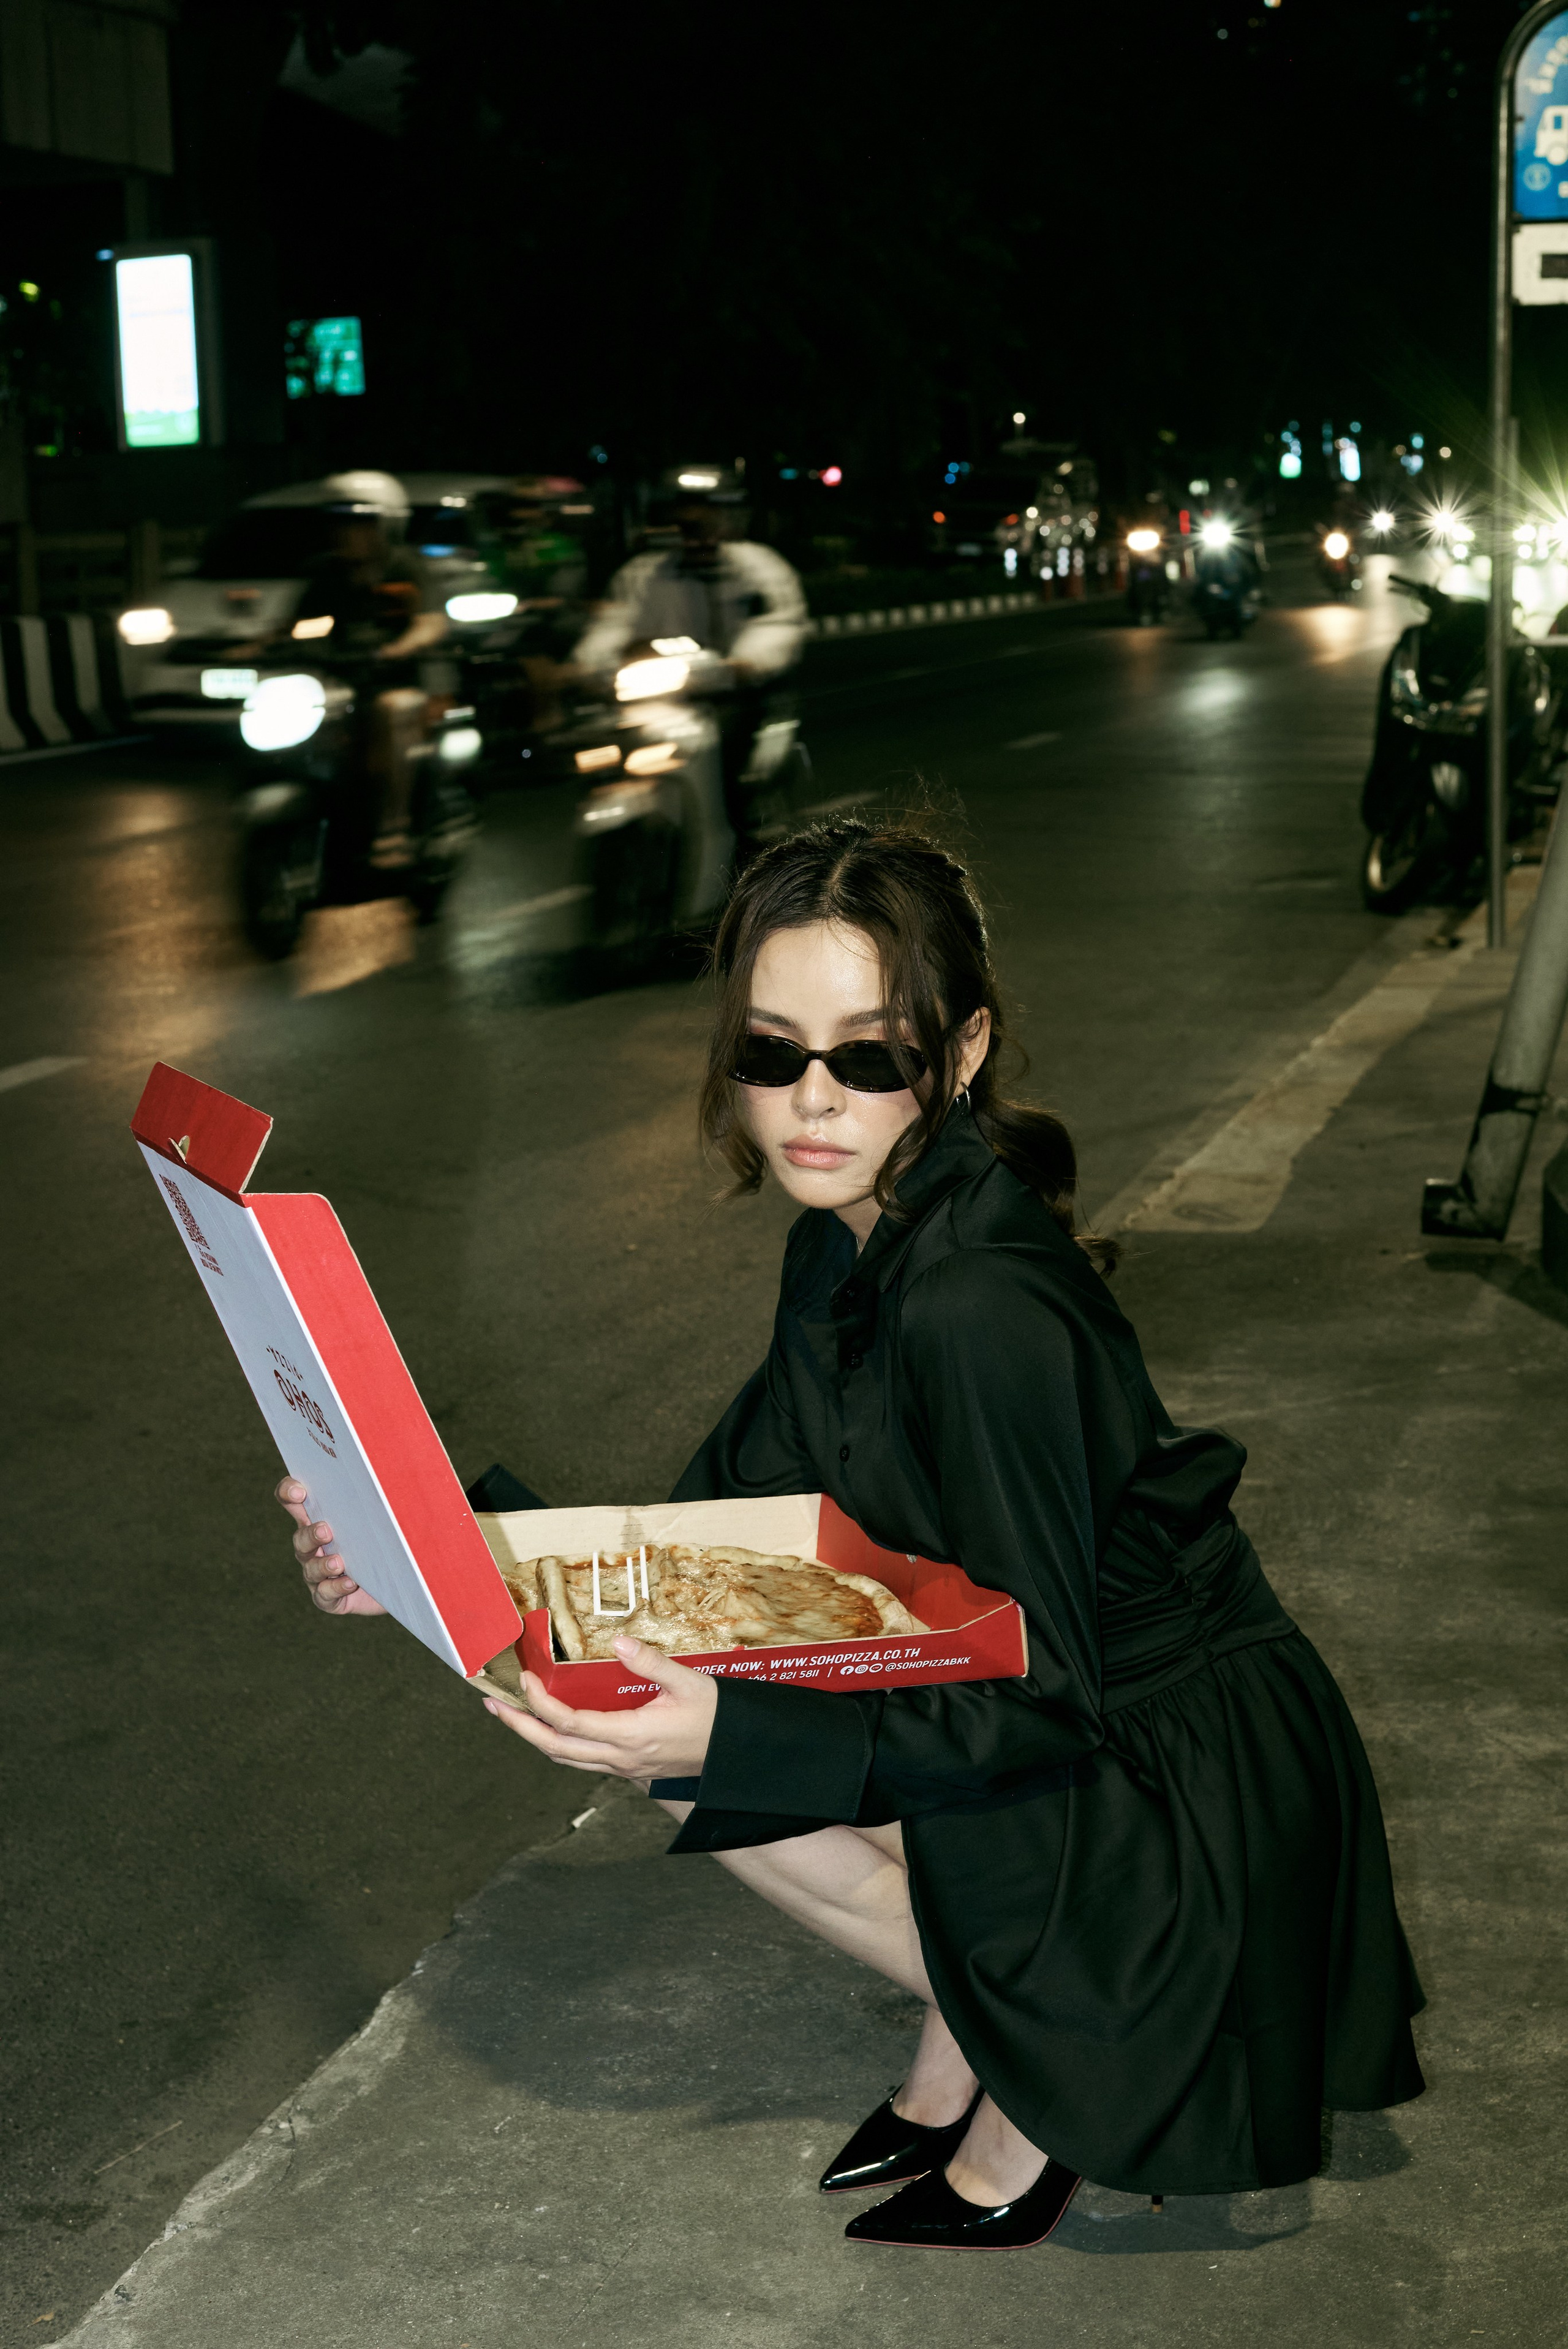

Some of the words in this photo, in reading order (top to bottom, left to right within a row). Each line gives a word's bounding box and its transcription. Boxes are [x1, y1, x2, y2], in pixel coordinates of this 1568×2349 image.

[268, 1344, 302, 1381] PIZZA
[273, 1369, 335, 1444] SOHO
[729, 1661, 764, 1673] NOW:
[770, 1648, 921, 1669] WWW.SOHOPIZZA.CO.TH
[779, 1671, 797, 1680] 821
[799, 1669, 820, 1678] 5811
[884, 1656, 971, 1672] @SOHOPIZZABKK
[617, 1684, 647, 1694] OPEN
